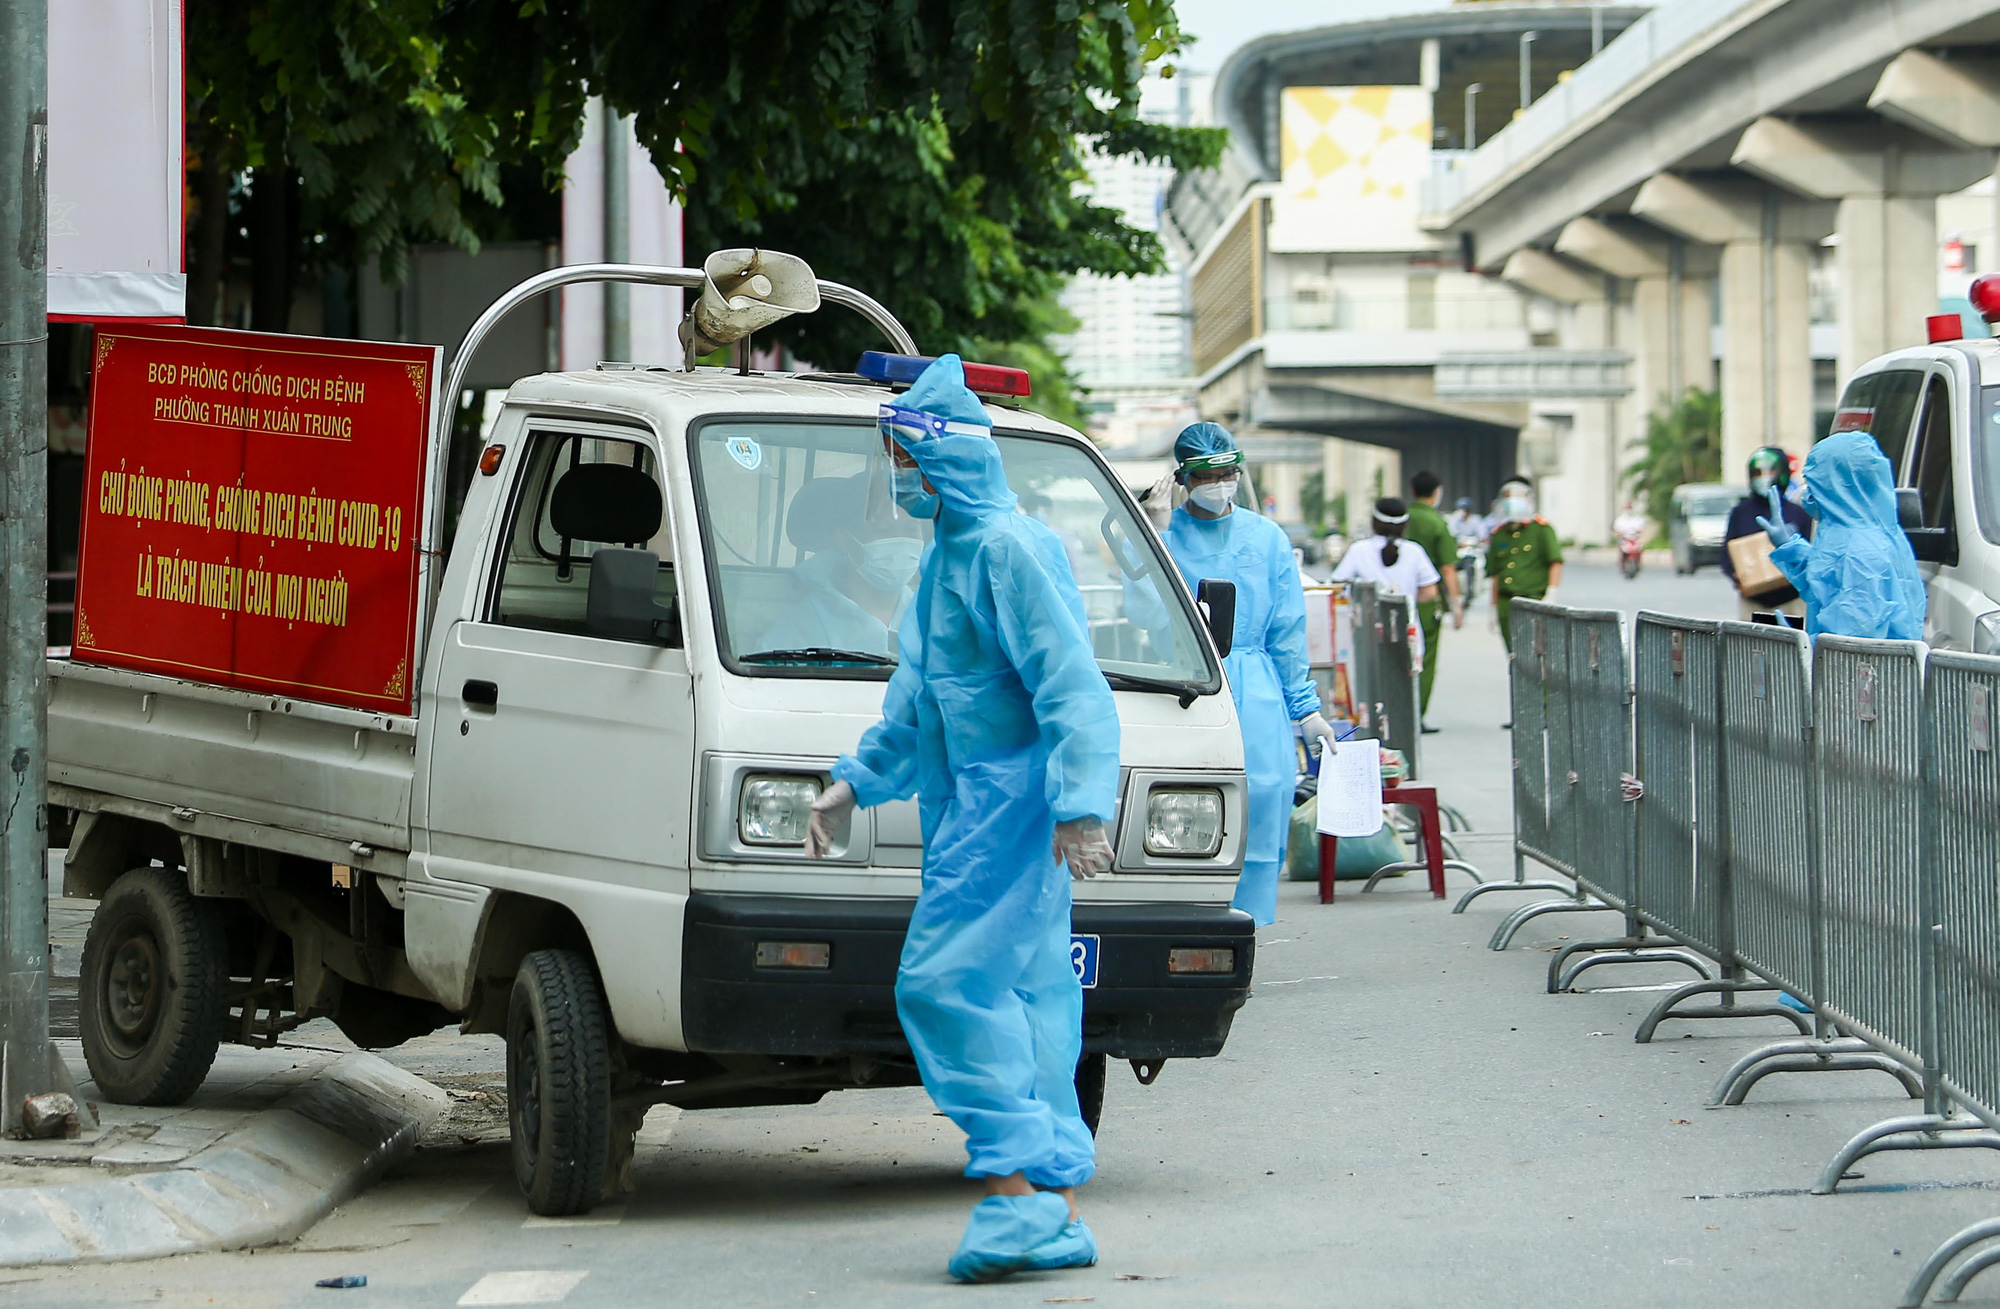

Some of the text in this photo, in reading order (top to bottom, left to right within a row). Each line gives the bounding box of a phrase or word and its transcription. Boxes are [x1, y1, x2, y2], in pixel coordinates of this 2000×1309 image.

[148, 362, 365, 406] BCĐ PHÒNG CHỐNG DỊCH BỆNH
[154, 395, 352, 438] PHƯỜNG THANH XUÂN TRUNG
[100, 457, 401, 552] CHỦ ĐỘNG PHÒNG, CHỐNG DỊCH BỆNH COVID-19
[136, 545, 349, 630] LÀ TRÁCH NHIỆM CỦA MỌI NGƯỜI
